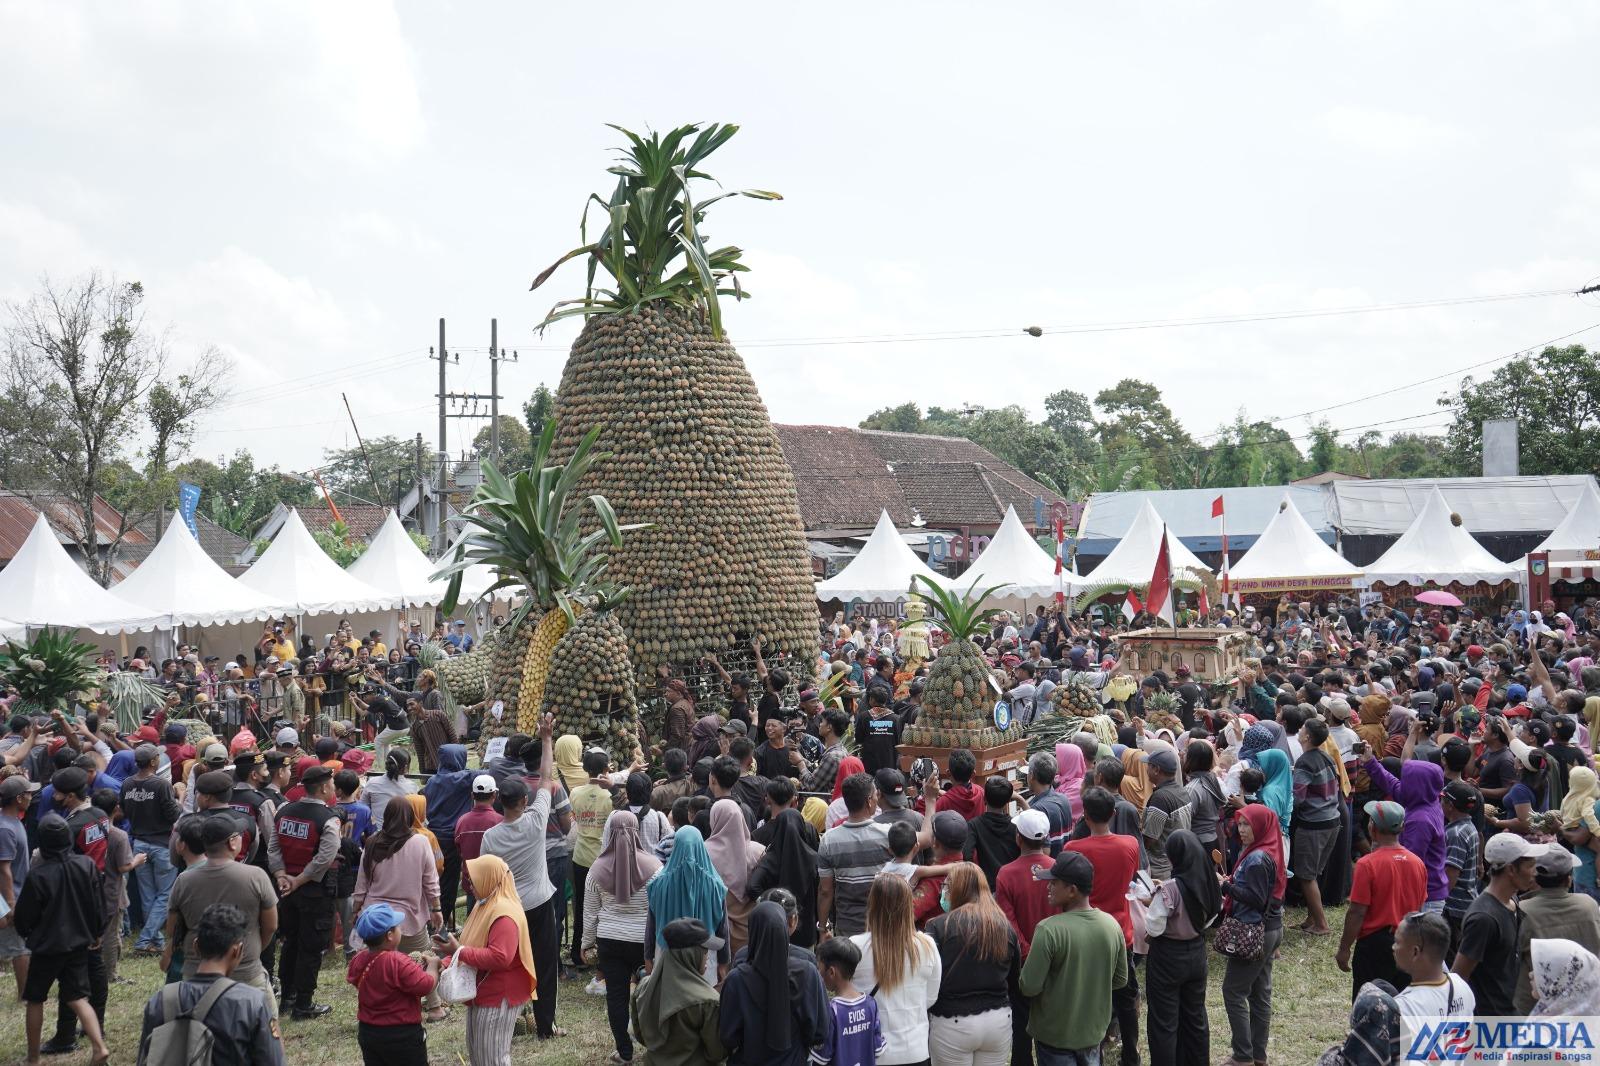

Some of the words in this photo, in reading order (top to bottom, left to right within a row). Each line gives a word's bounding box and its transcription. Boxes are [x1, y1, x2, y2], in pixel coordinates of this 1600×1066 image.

[854, 603, 895, 617] STAND
[281, 820, 309, 838] POLISI
[848, 1008, 866, 1024] EVOS
[842, 1021, 871, 1036] ALBERT
